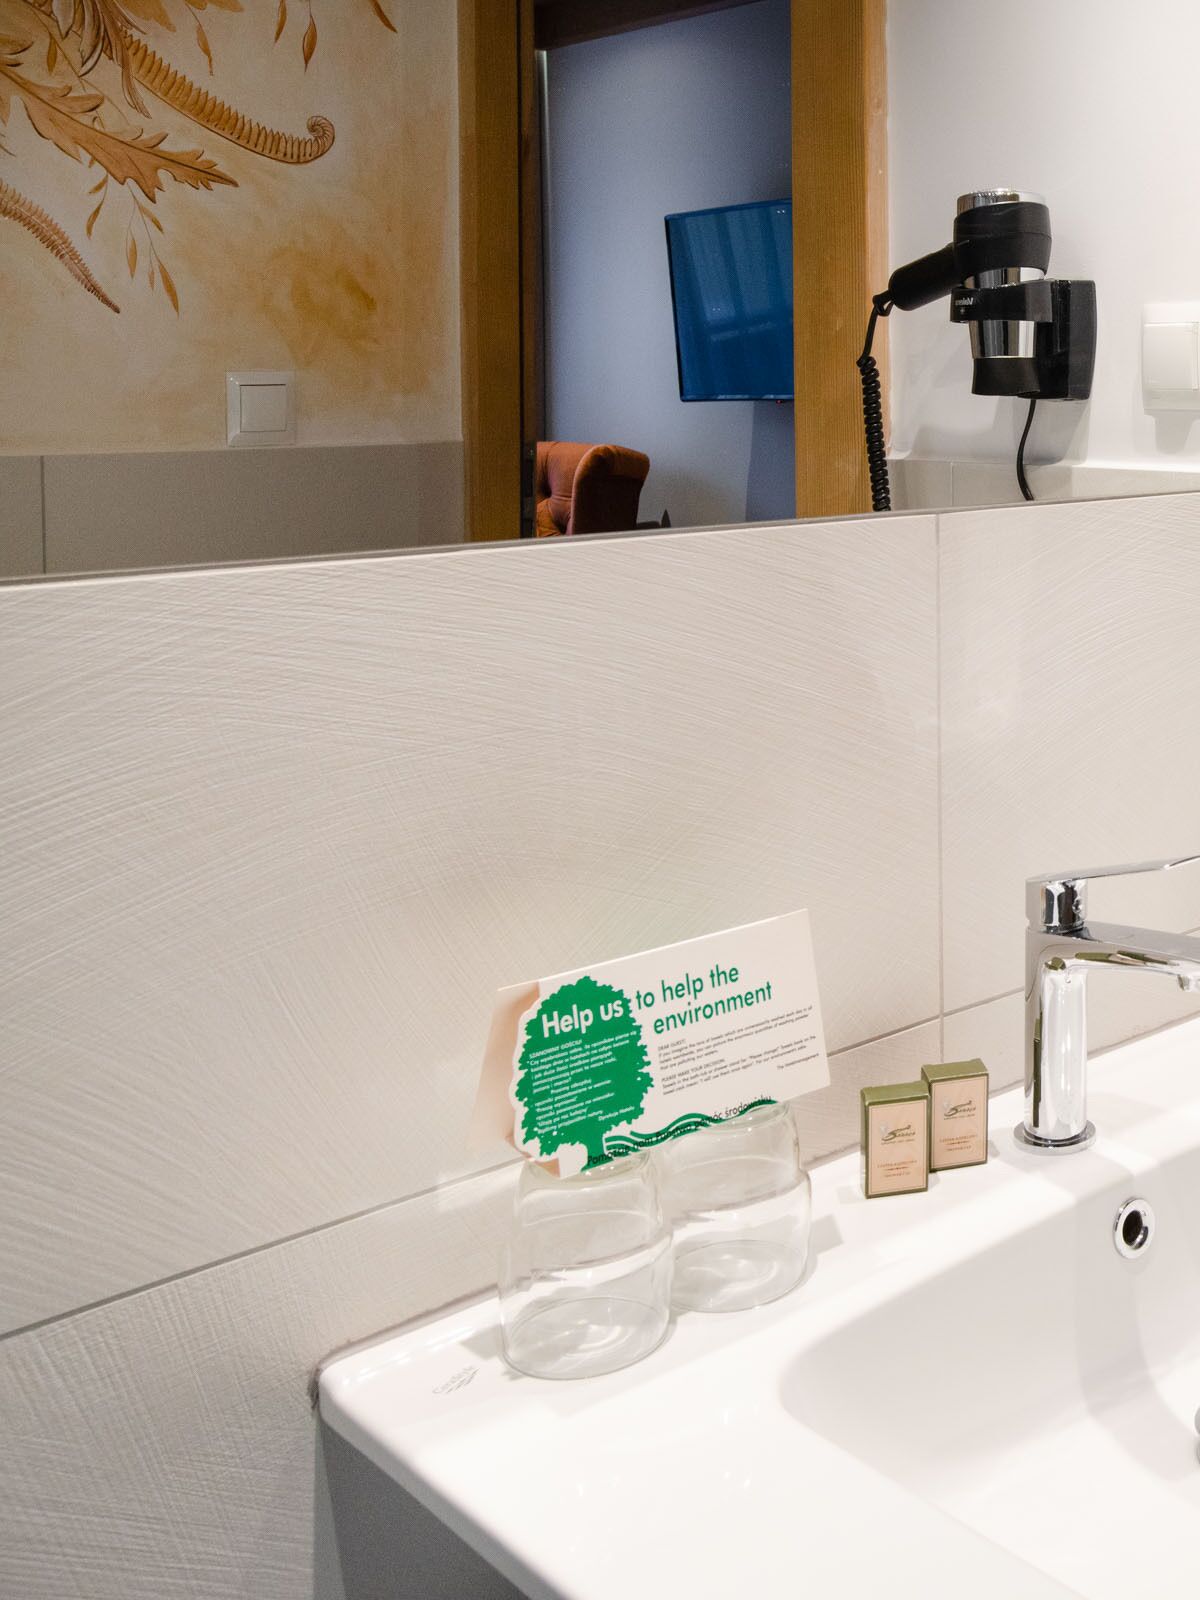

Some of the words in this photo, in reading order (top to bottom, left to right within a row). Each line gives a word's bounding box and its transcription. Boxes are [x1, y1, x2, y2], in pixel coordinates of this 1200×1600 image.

[541, 1003, 594, 1038] Help
[600, 999, 624, 1022] us
[636, 989, 655, 1011] to
[661, 971, 704, 1003] help
[709, 963, 739, 989] the
[653, 981, 773, 1034] environment
